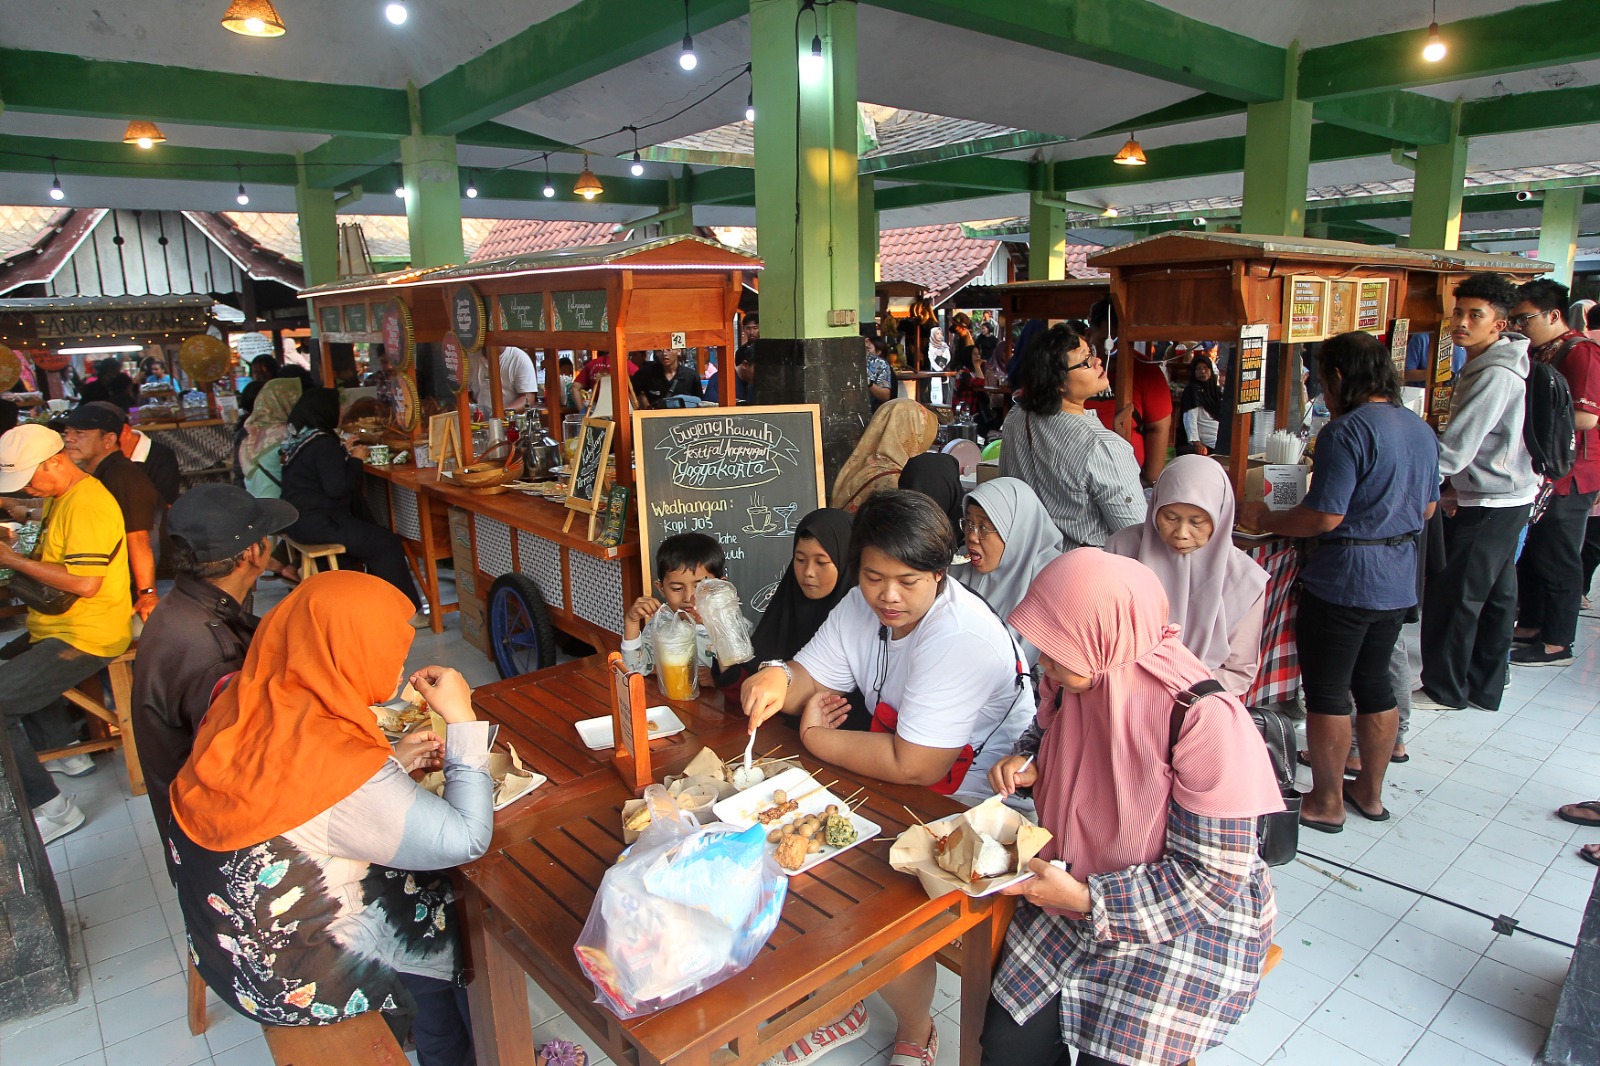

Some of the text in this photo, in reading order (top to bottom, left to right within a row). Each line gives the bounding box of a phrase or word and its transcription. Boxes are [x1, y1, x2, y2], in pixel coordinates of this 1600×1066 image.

[49, 311, 176, 336] ANGKRINGAN
[673, 335, 682, 345] 42
[673, 418, 773, 443] Sugeng Rawuh
